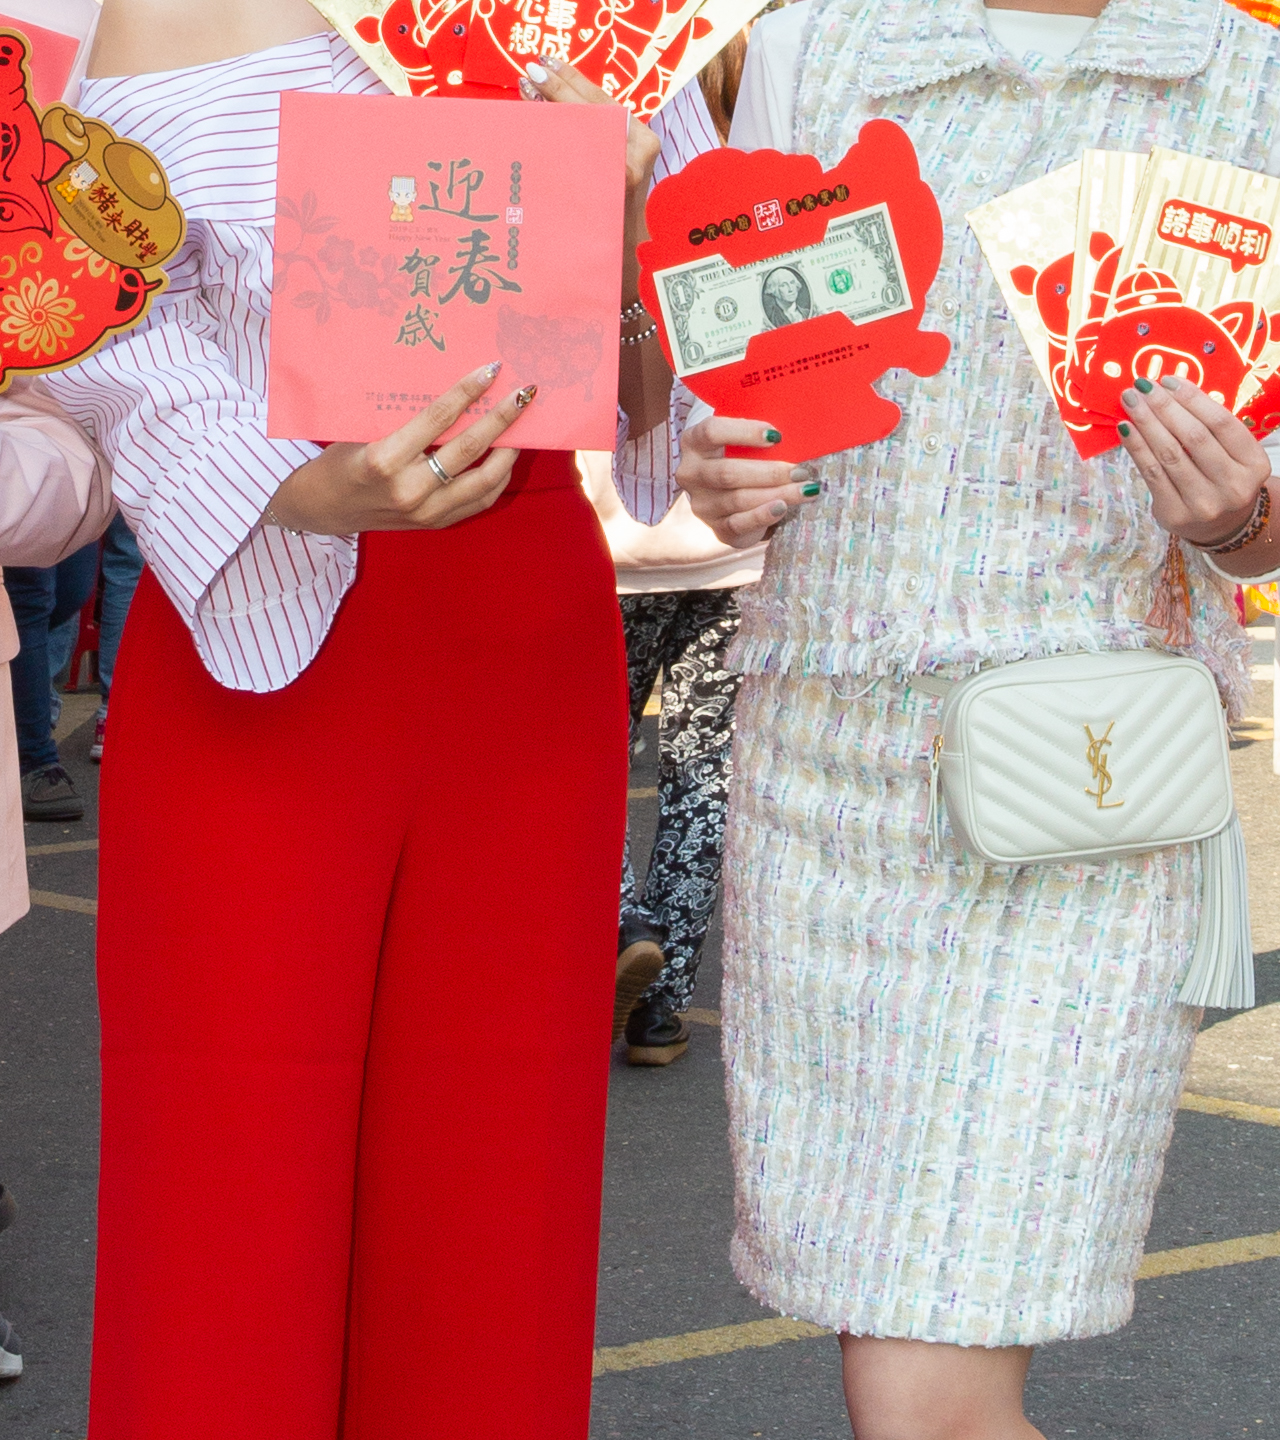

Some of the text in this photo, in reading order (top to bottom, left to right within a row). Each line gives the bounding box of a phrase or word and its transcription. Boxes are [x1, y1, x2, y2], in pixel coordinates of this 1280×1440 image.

[418, 158, 522, 305] 迎春
[1160, 203, 1269, 261] 諸事順利
